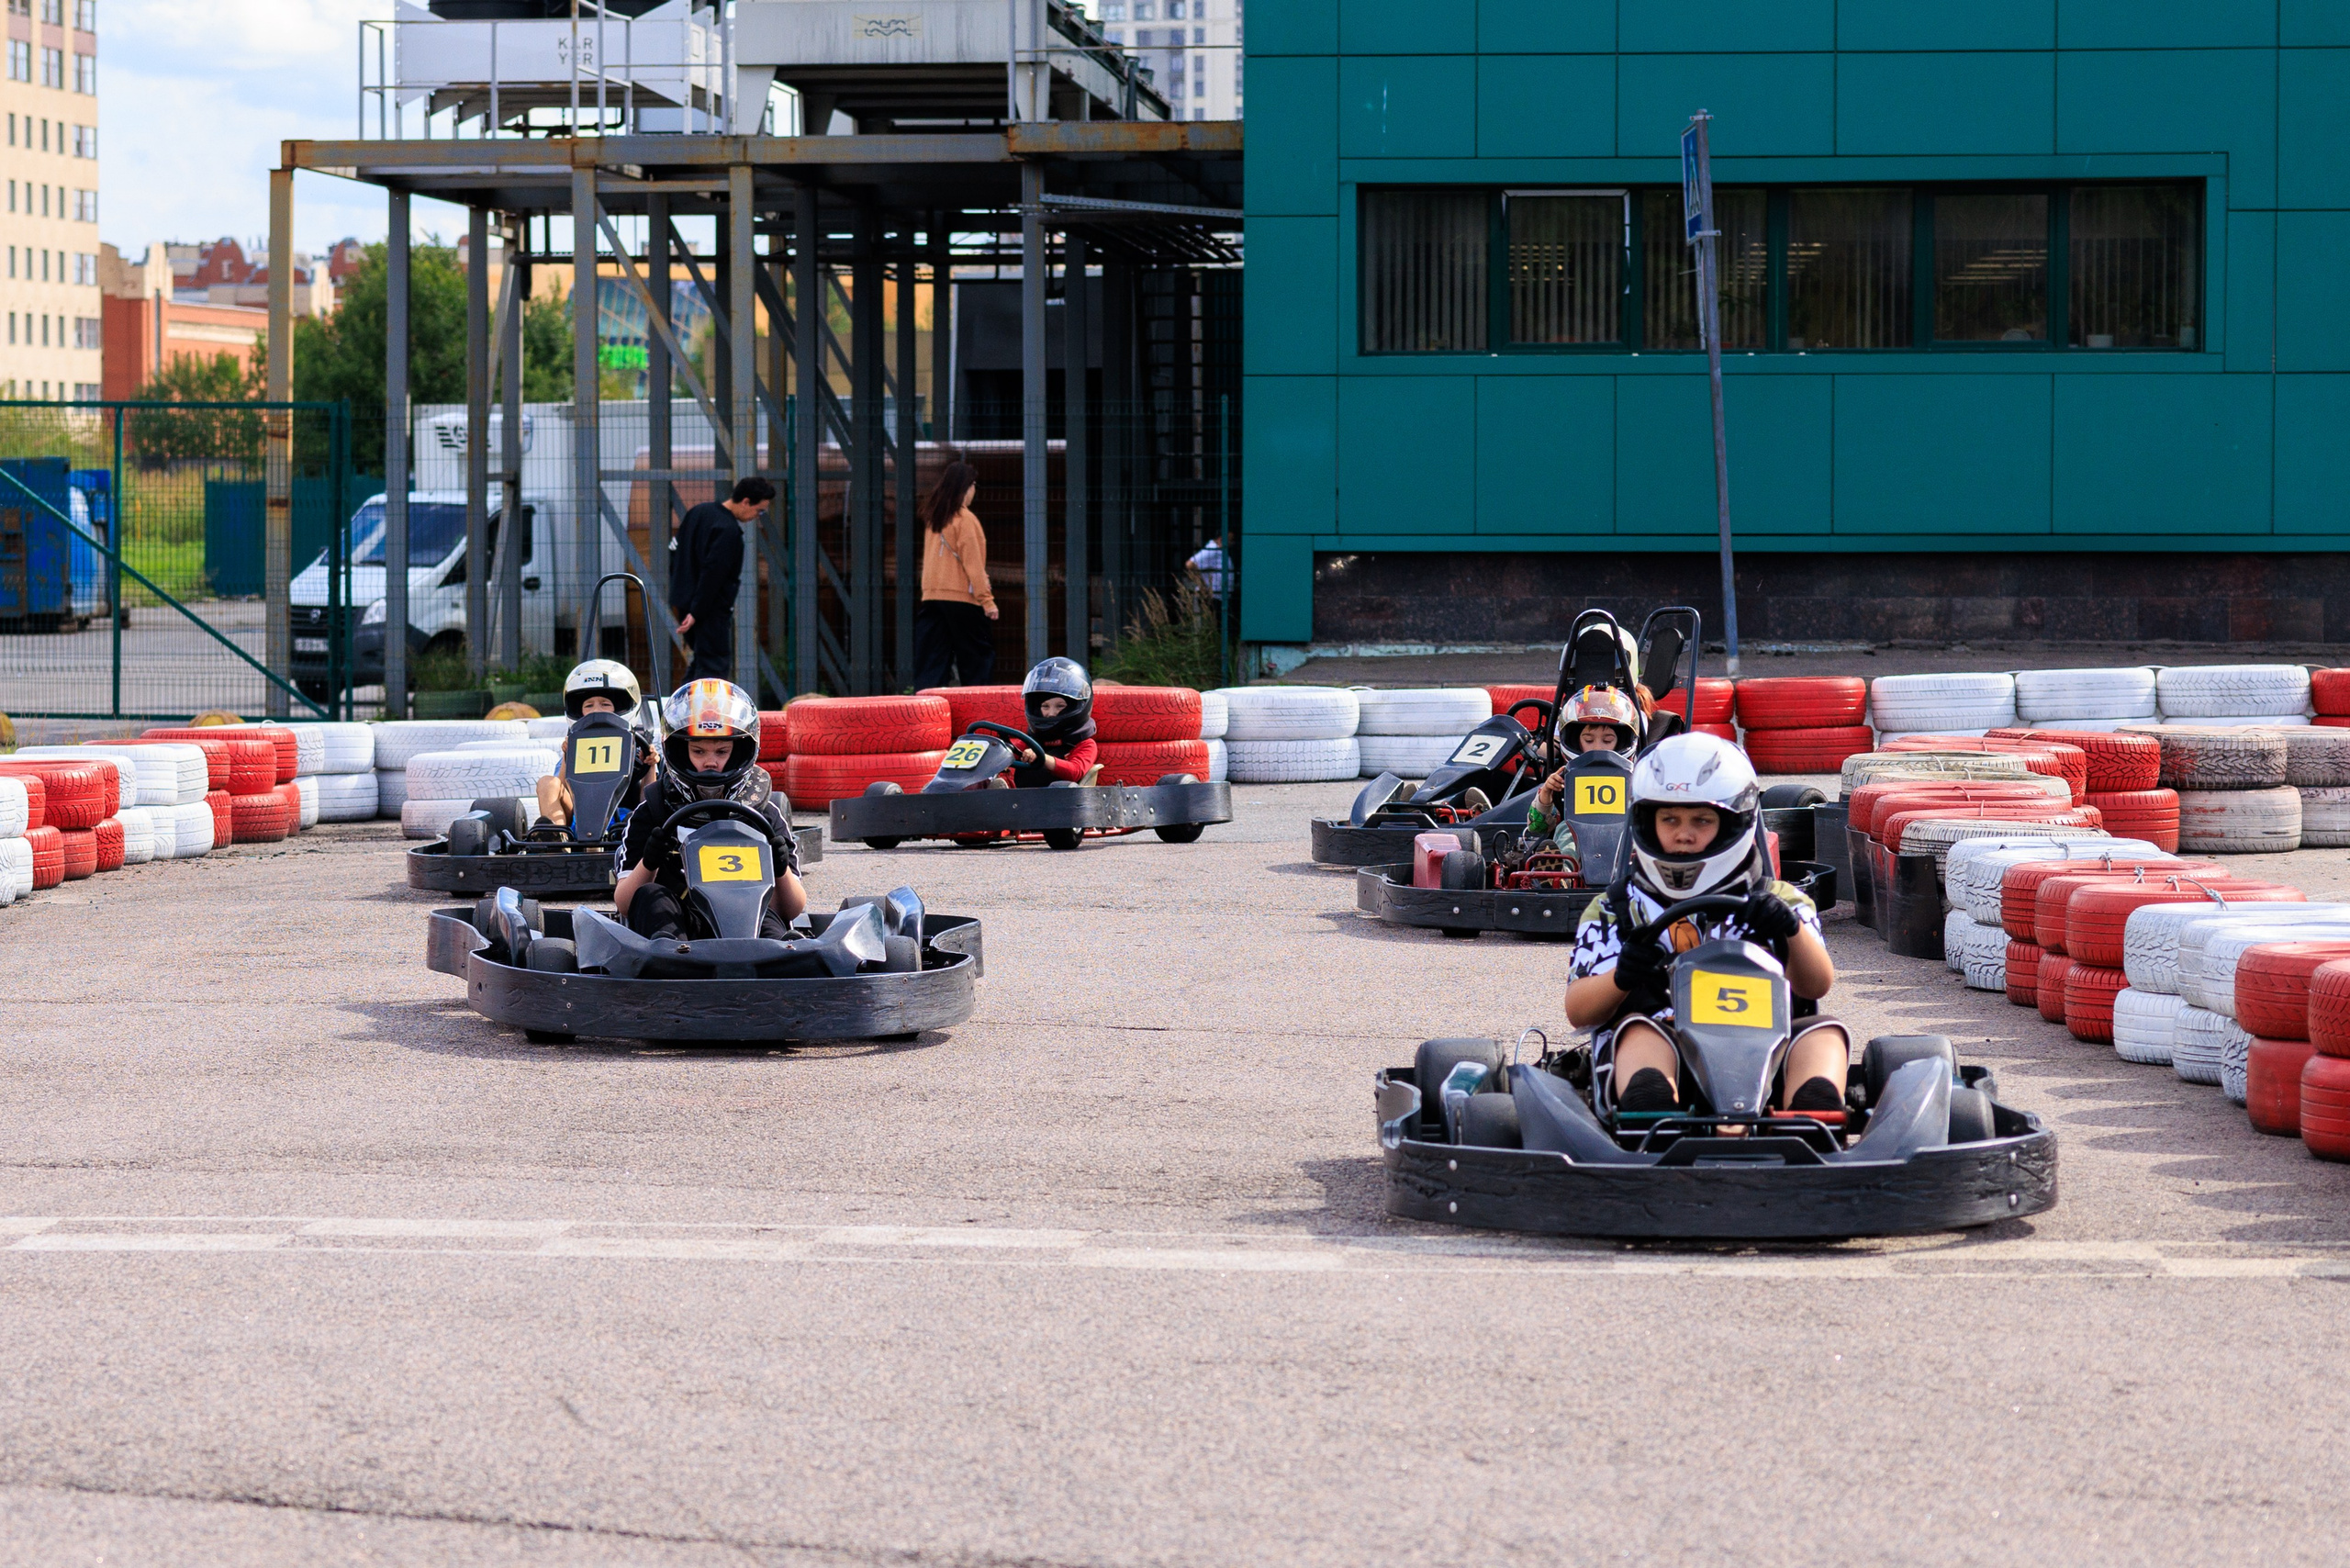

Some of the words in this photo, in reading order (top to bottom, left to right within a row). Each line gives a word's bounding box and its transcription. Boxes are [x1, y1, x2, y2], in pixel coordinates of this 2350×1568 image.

[558, 52, 593, 64] YR
[588, 745, 610, 764] 11
[946, 746, 982, 761] 26
[1467, 742, 1491, 757] 2
[1584, 785, 1617, 805] 10
[1666, 782, 1692, 792] GXT
[717, 855, 744, 872] 3
[1716, 987, 1750, 1014] 5
